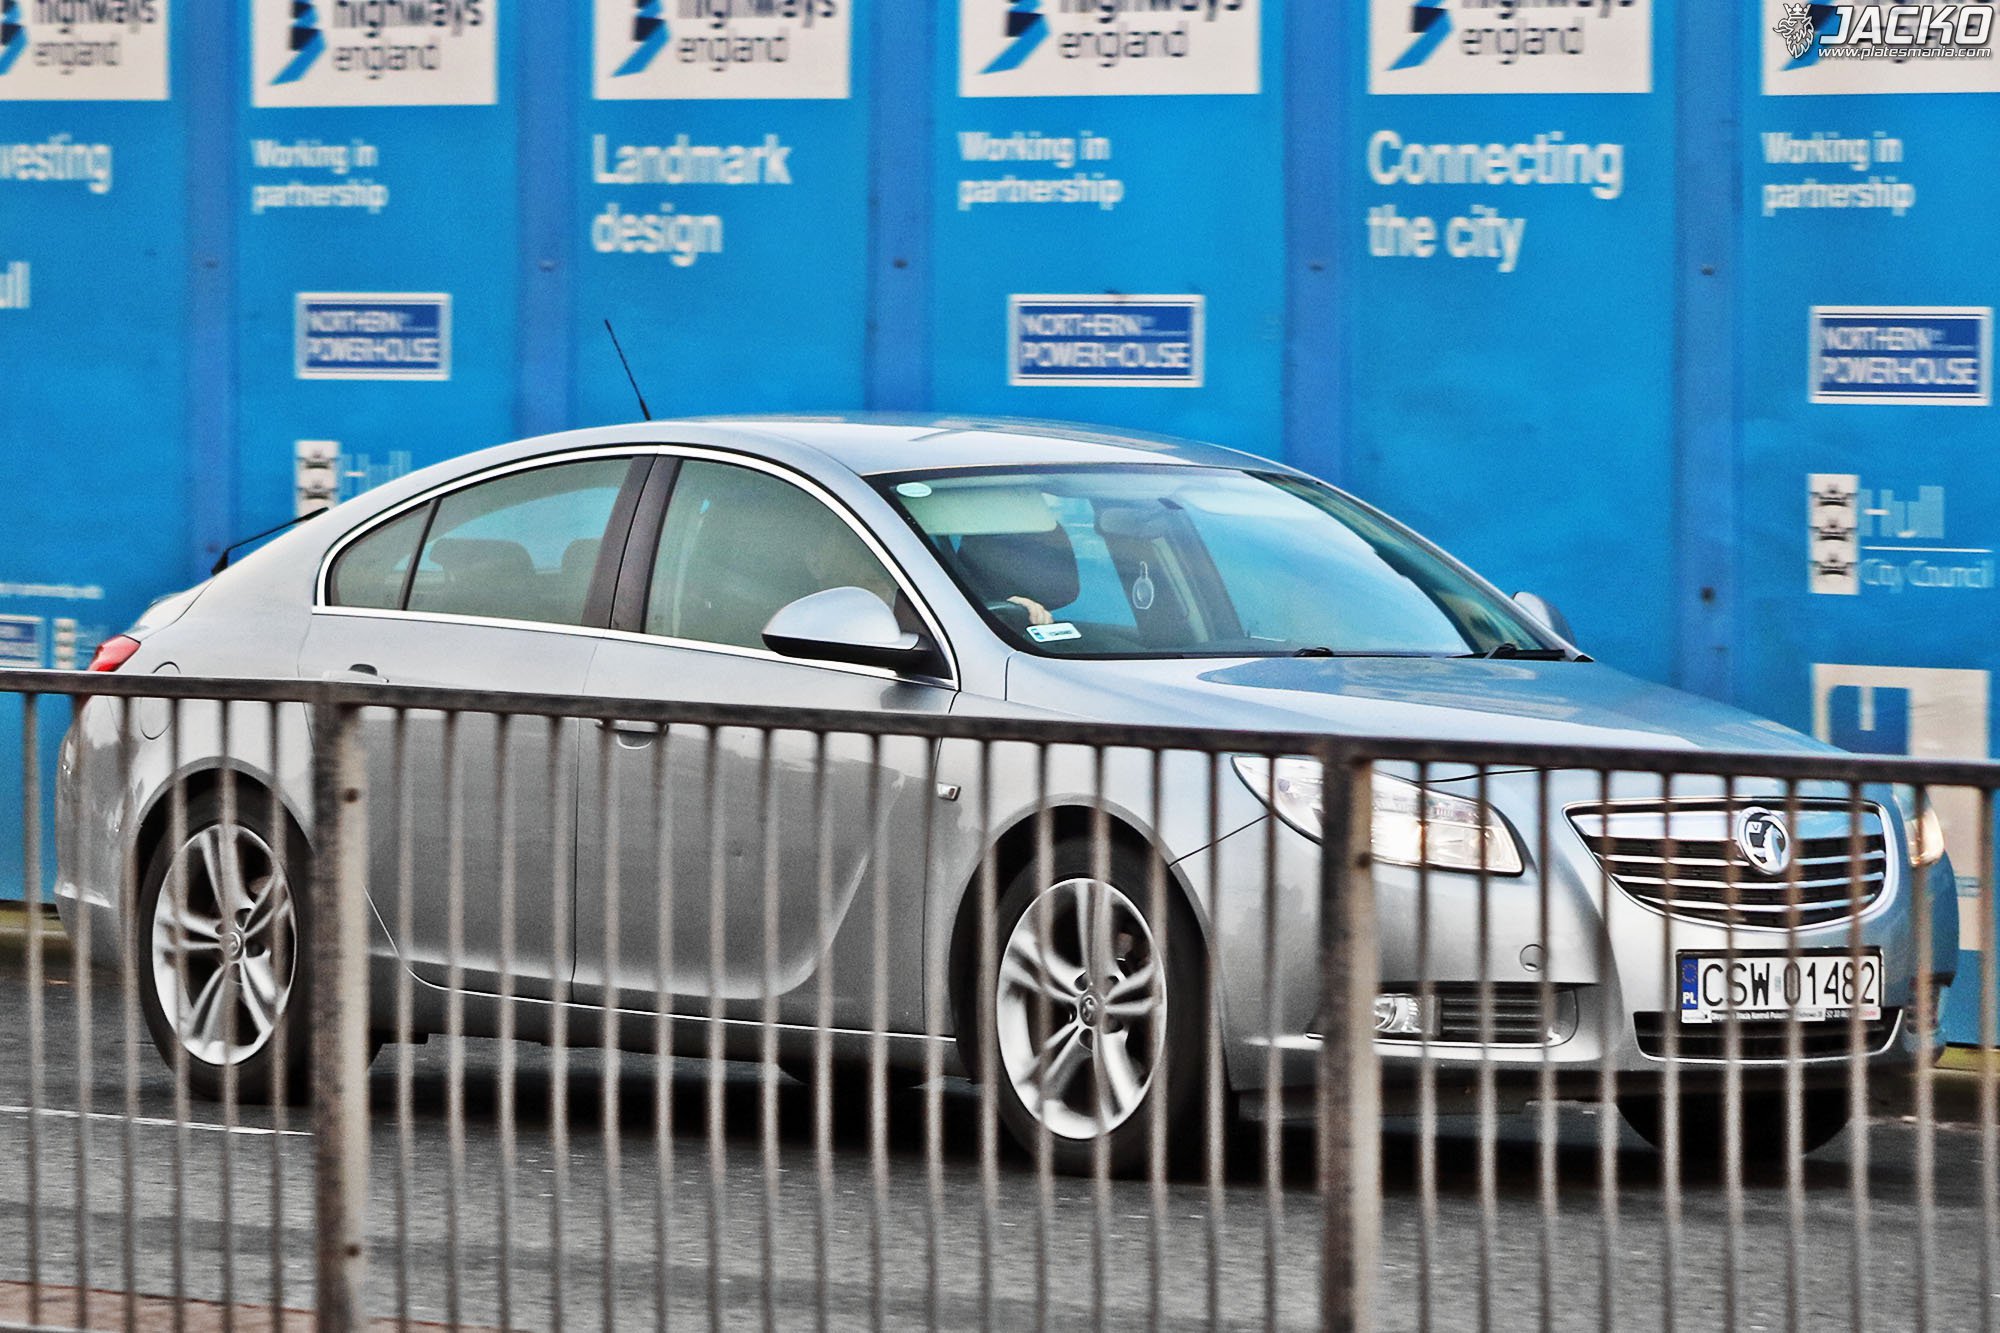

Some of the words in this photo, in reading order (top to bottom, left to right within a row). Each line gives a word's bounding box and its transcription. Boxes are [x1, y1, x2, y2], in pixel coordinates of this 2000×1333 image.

[333, 36, 440, 79] england
[677, 27, 789, 72] england
[1059, 21, 1189, 67] england
[1461, 17, 1586, 65] england
[252, 139, 348, 174] Working
[351, 138, 379, 167] in
[592, 134, 792, 184] Landmark
[957, 131, 1076, 168] Working
[1079, 130, 1110, 160] in
[1367, 130, 1624, 199] Connecting
[1761, 132, 1870, 171] Working
[1873, 131, 1903, 162] in
[253, 178, 389, 214] partnership
[957, 172, 1124, 211] partnership
[1761, 176, 1916, 217] partnership
[592, 203, 723, 266] design
[1366, 204, 1436, 257] the
[1446, 204, 1527, 273] city
[1682, 991, 1697, 1005] PL
[1702, 961, 1770, 1007] CSW
[1783, 961, 1875, 1007] 01482
